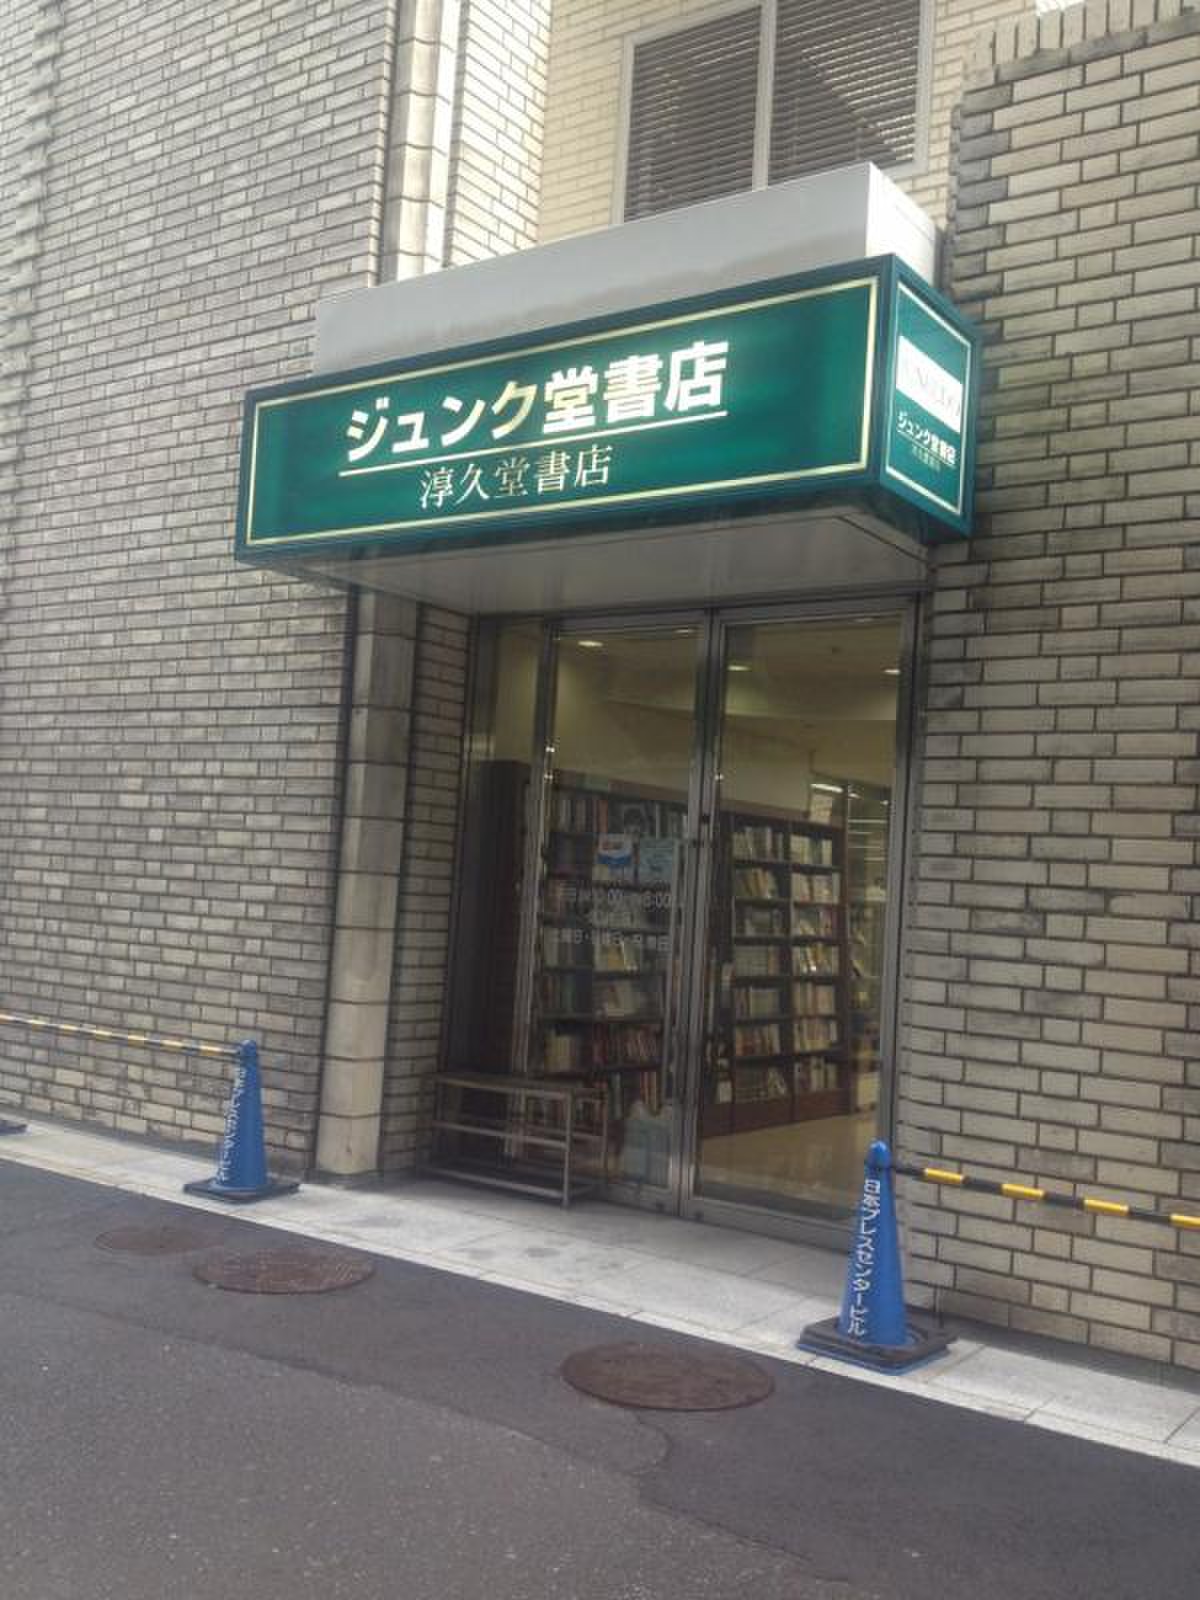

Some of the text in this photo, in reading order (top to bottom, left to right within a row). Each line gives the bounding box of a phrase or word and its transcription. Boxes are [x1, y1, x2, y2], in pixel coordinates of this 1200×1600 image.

[346, 341, 729, 462] ジュンク堂書店
[419, 444, 614, 509] 淳久堂書店
